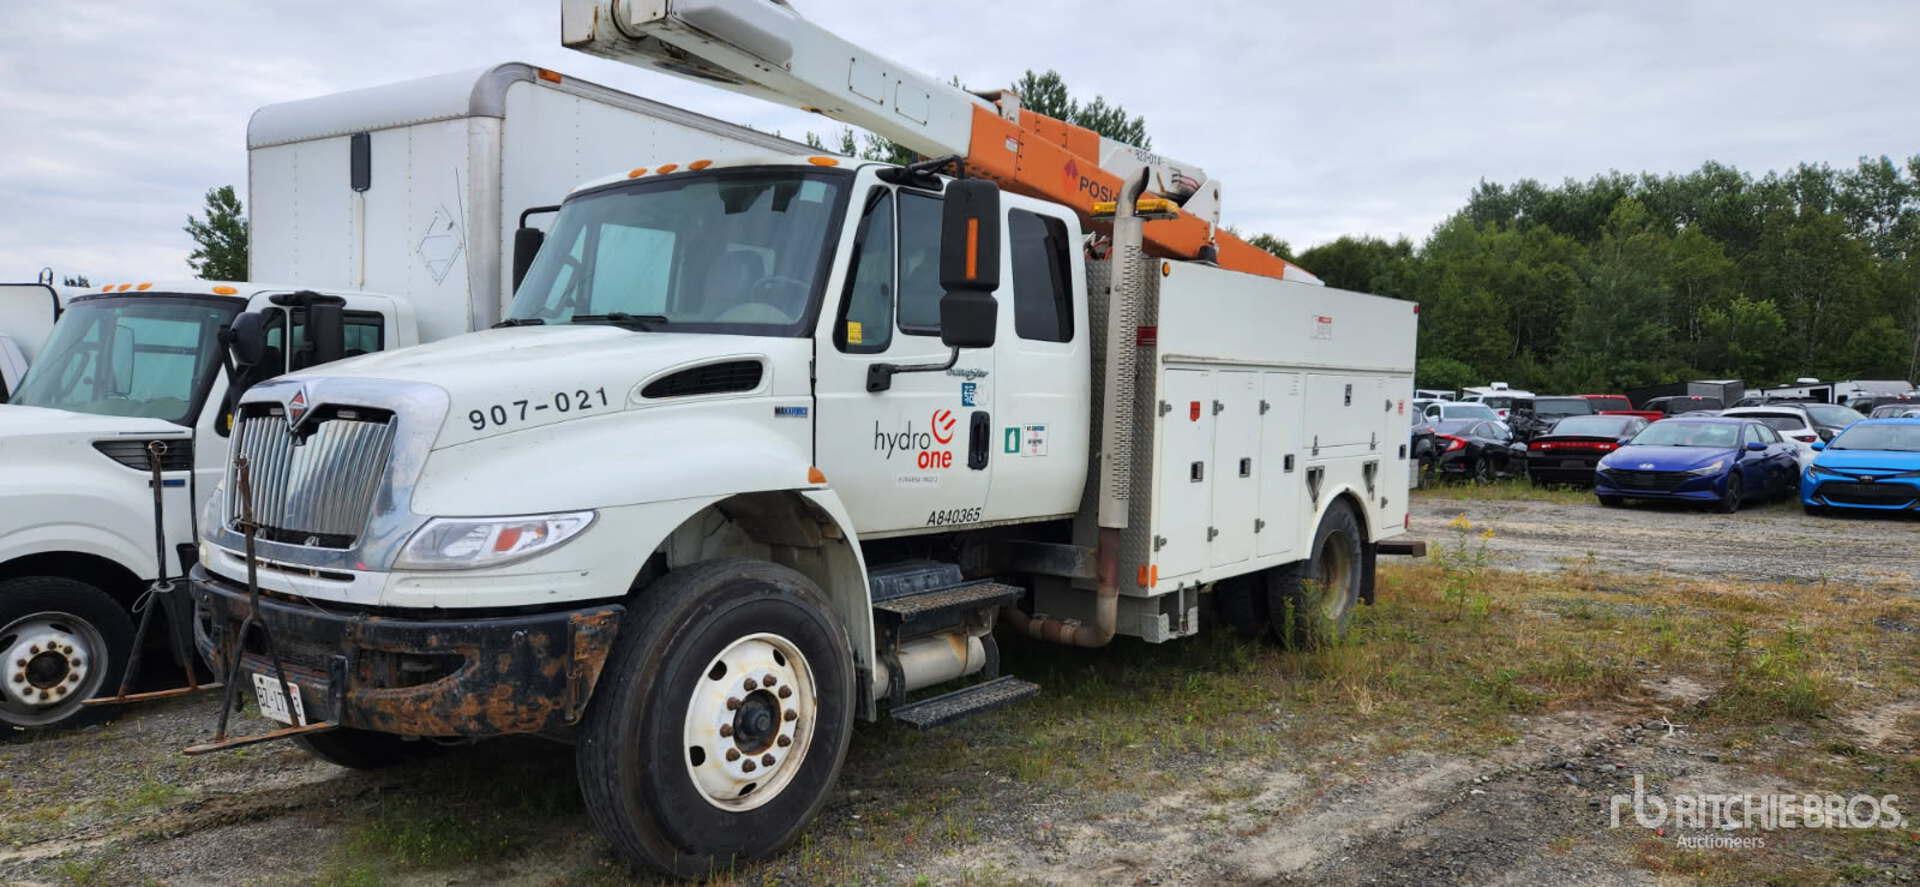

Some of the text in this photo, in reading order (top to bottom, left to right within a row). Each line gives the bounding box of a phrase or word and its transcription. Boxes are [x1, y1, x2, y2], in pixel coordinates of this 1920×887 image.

[1079, 175, 1119, 203] POSI-
[468, 386, 608, 431] 907-021
[874, 419, 930, 460] hydro
[917, 450, 952, 469] one
[926, 506, 982, 526] A840365
